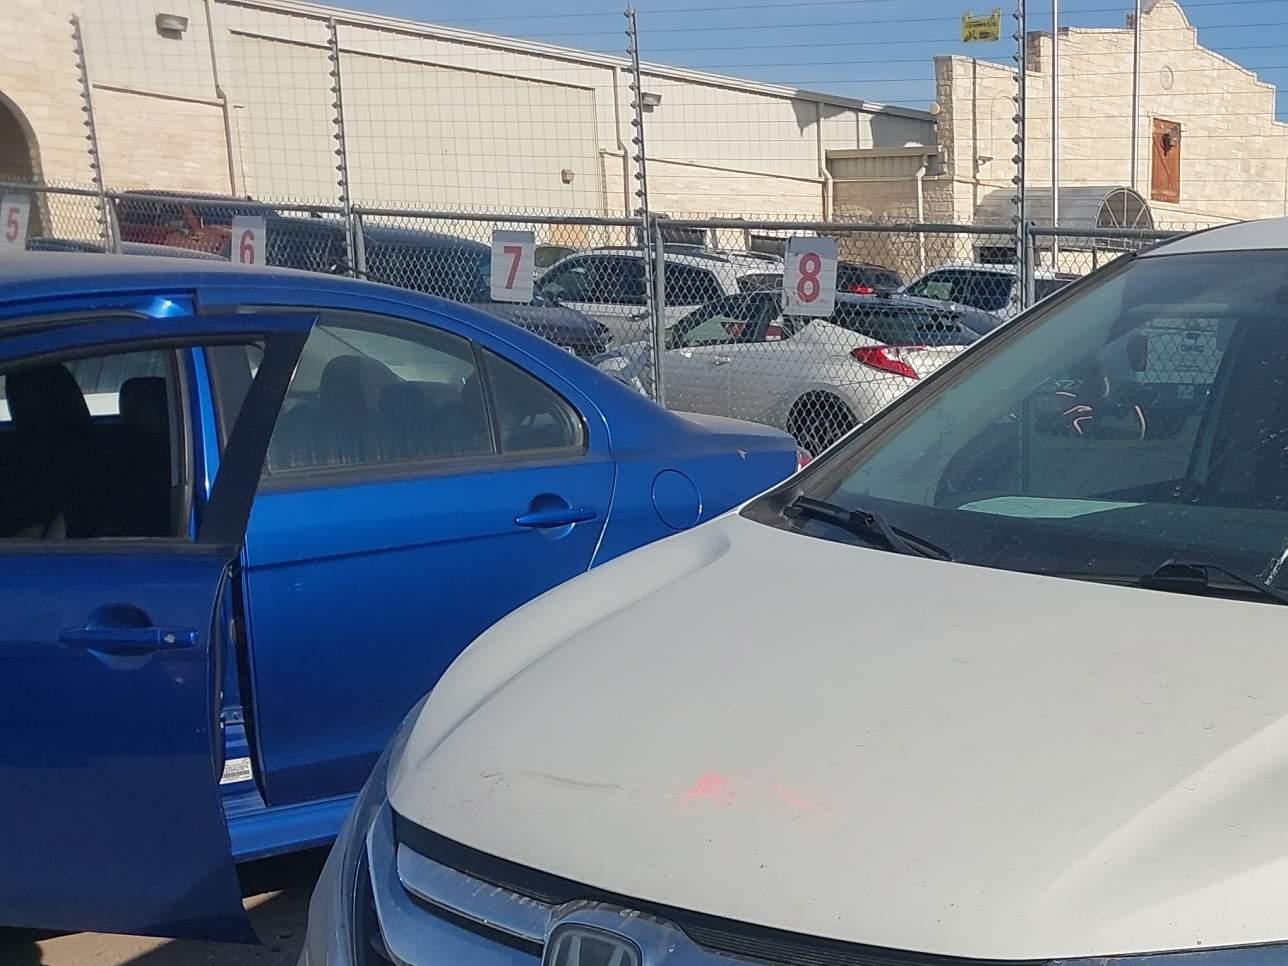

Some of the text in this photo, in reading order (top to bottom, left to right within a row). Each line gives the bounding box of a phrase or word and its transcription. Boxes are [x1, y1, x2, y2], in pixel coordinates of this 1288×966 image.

[6, 206, 20, 243] 5
[239, 229, 255, 264] 6
[502, 245, 523, 290] 7
[796, 252, 822, 303] 8
